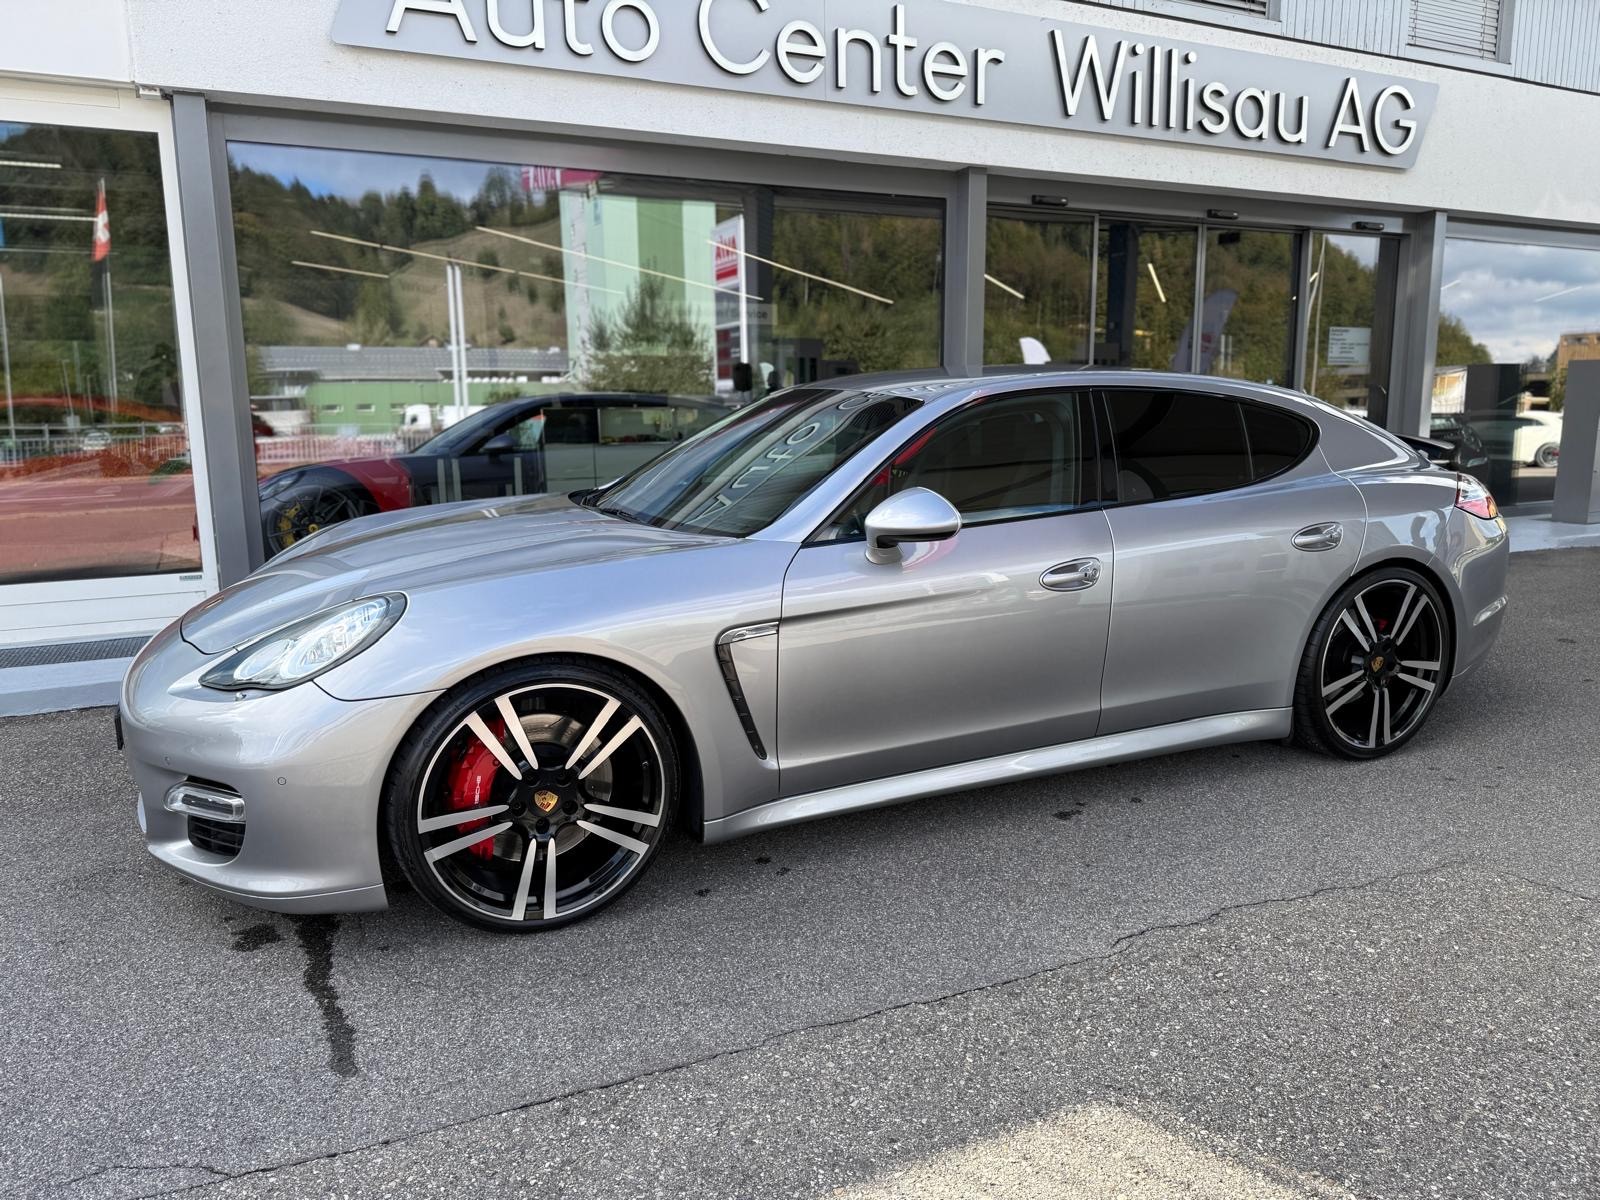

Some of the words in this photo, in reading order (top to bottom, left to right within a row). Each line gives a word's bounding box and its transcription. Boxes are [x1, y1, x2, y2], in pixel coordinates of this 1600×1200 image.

[697, 0, 1005, 105] Center
[1050, 29, 1309, 143] Willisau
[1326, 77, 1418, 155] AG
